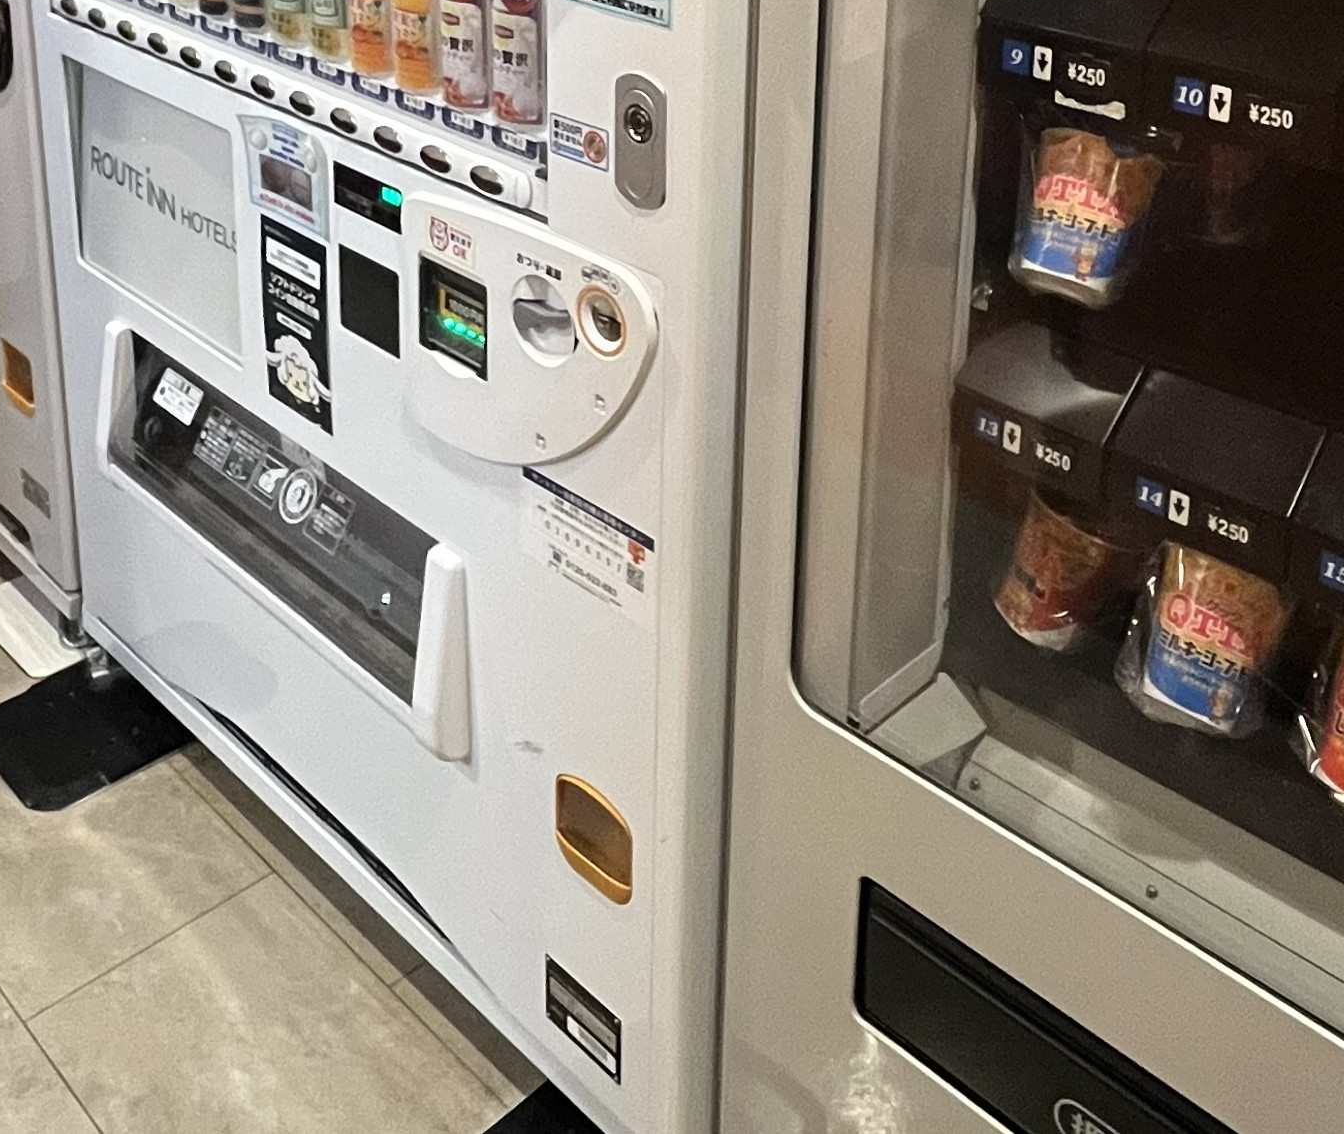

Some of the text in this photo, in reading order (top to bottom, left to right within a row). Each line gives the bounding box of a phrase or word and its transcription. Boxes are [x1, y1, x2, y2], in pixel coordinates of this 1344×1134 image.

[1011, 47, 1106, 87] 9 ¥250
[1175, 83, 1294, 130] 10 ¥250
[978, 417, 1071, 471] 13 ¥250
[1138, 485, 1249, 544] 14 ¥250
